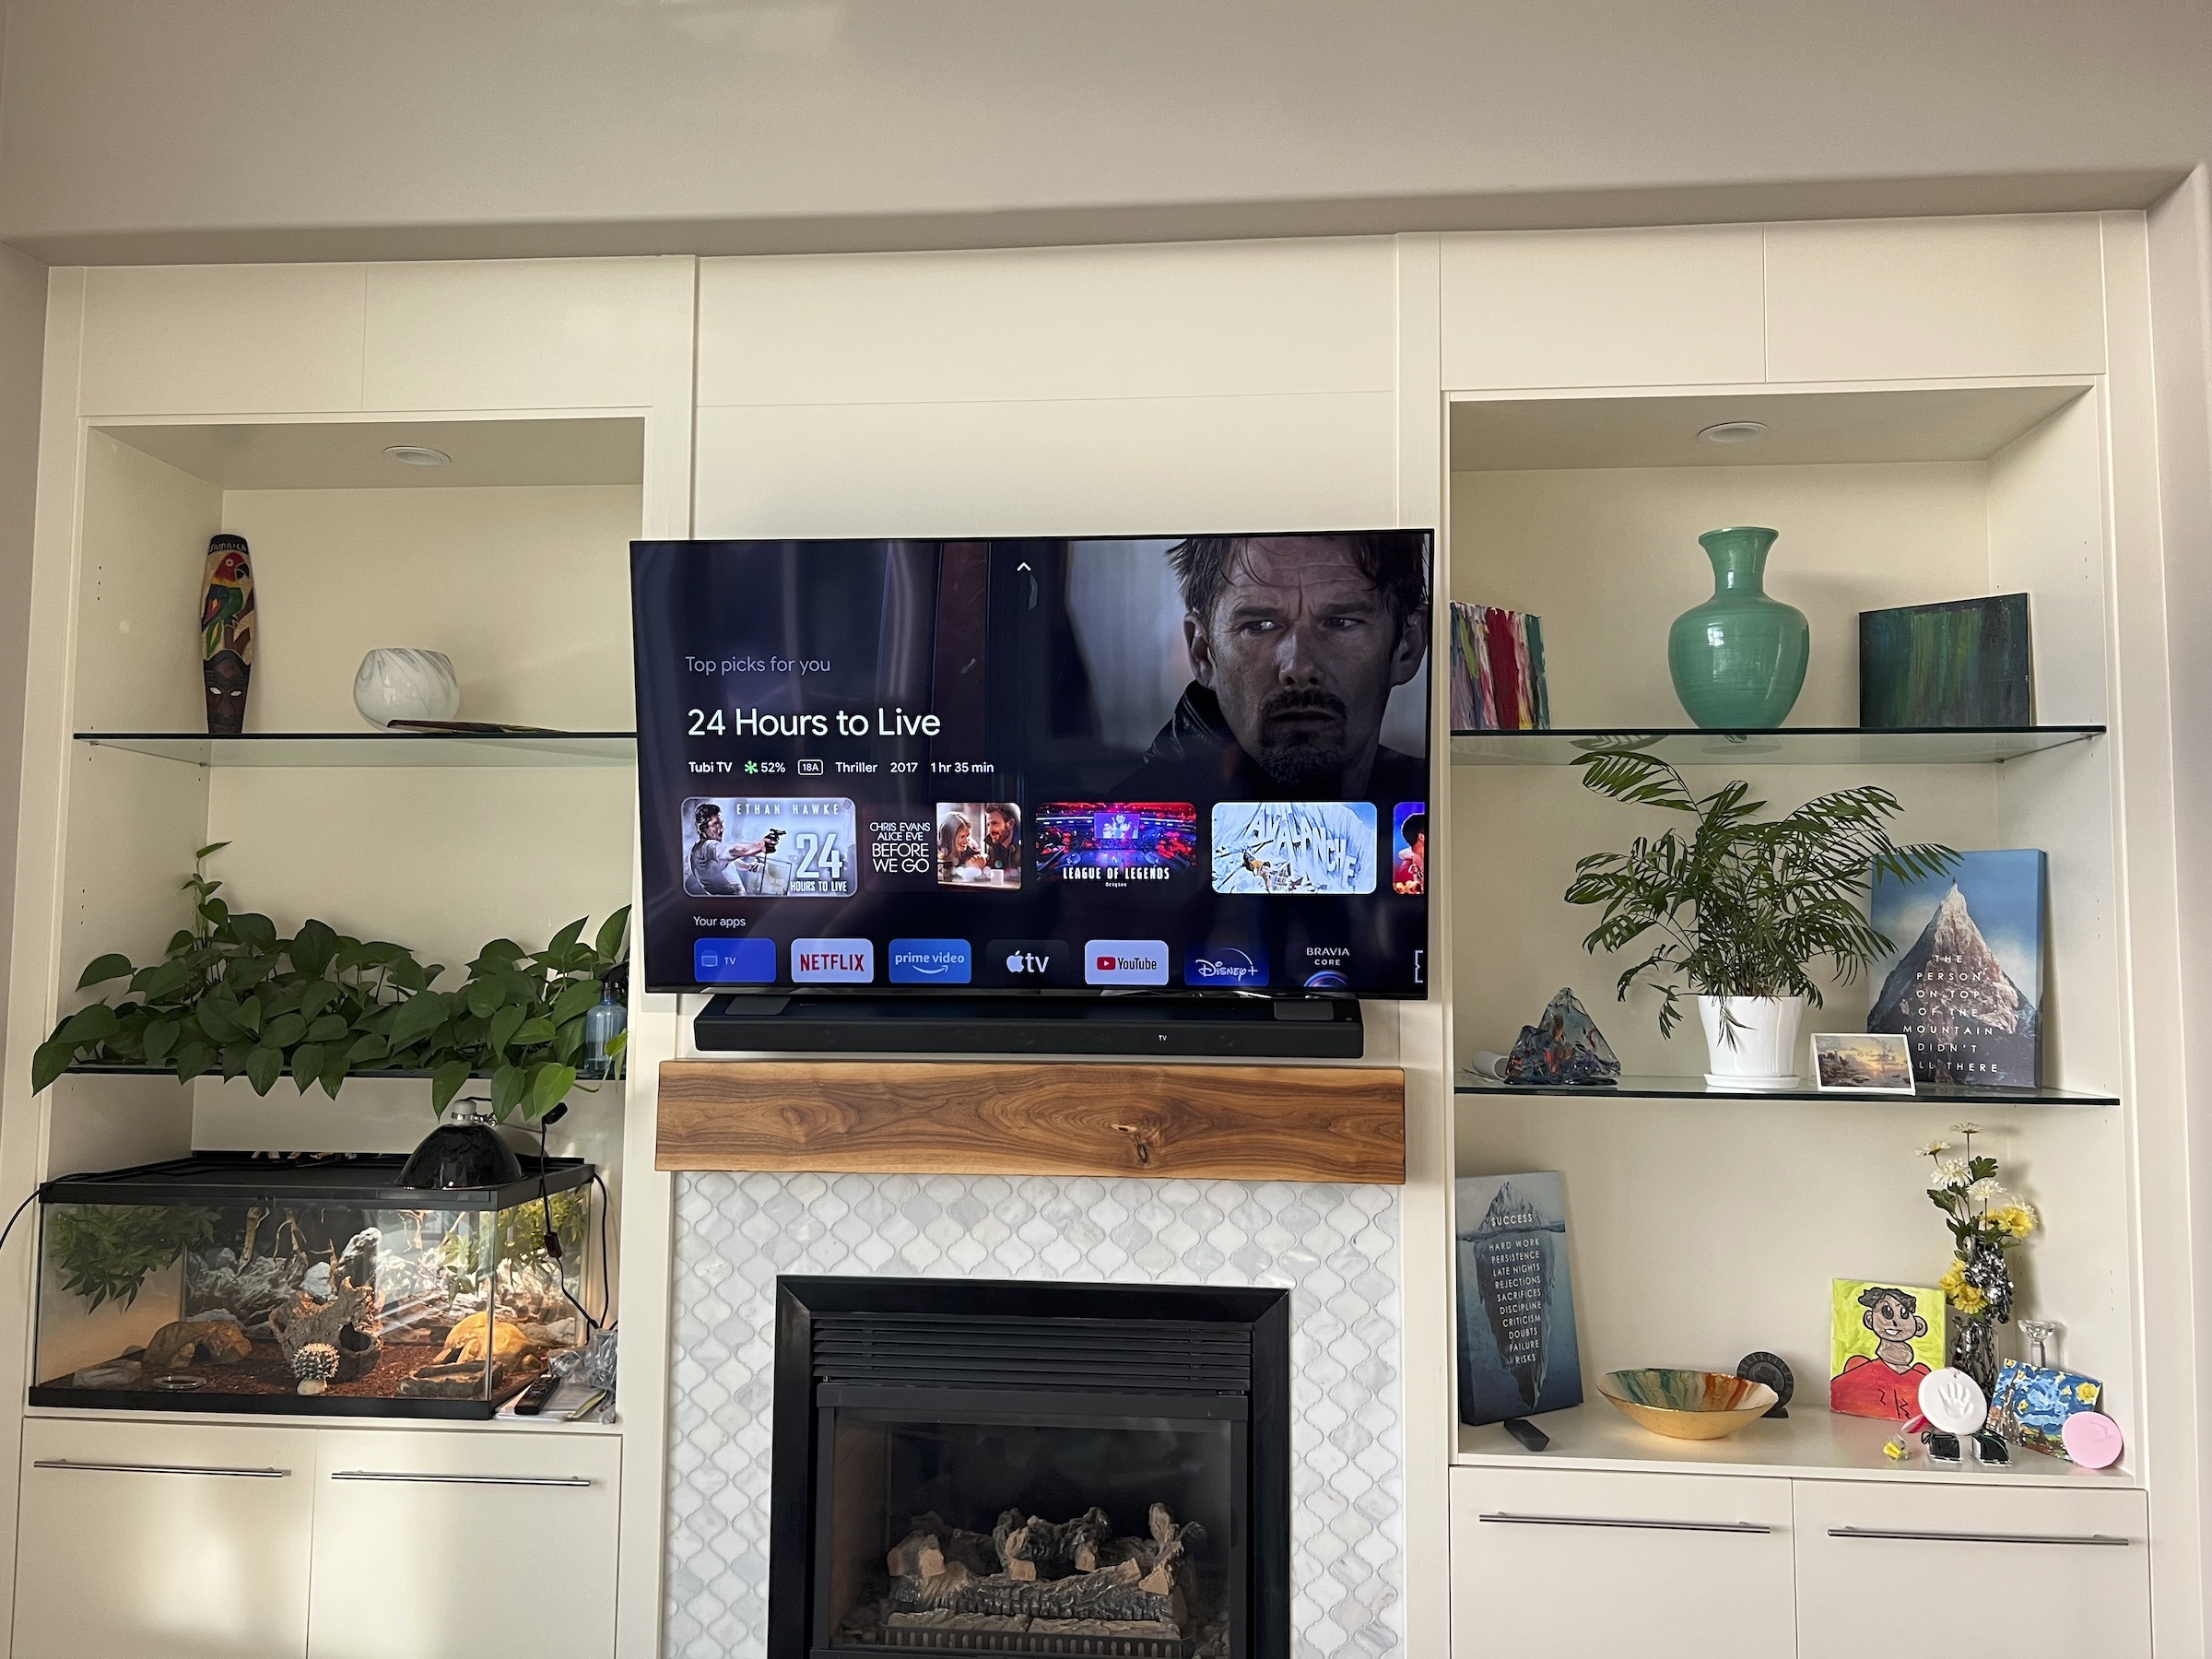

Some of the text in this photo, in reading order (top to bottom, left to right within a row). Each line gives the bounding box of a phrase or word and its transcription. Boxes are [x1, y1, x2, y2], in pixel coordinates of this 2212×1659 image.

[685, 656, 830, 676] Top picks for you
[688, 708, 941, 736] 24 Hours to Live
[688, 761, 714, 773] Tubi
[716, 762, 733, 773] TV
[760, 762, 786, 773] 52%
[802, 763, 819, 772] 18A
[835, 761, 878, 773] Thriller
[890, 762, 918, 773] 2017
[937, 761, 951, 773] hr
[954, 762, 970, 773] 35
[971, 762, 994, 773] min
[736, 804, 839, 815] ETHAN HAWKE
[869, 822, 930, 831] CHRIS EVANS
[877, 831, 924, 841] ALICE EVE
[872, 843, 929, 857] BEFORE
[1248, 809, 1357, 888] AVALANCHE
[795, 833, 842, 879] 24
[872, 858, 929, 873] WE GO
[1063, 867, 1171, 880] LEAGUE OF LEGENDS
[791, 881, 847, 892] HOURS TO LIVE
[693, 916, 746, 928] Your apps
[1306, 947, 1349, 957] BRAVIA
[724, 957, 736, 965] TV
[800, 953, 865, 972] NETFLIX
[895, 951, 965, 966] prime video
[1025, 953, 1049, 973] tv
[1118, 958, 1157, 970] YouTube
[1936, 955, 1962, 963] THE
[1916, 972, 1981, 981] PERSON
[1916, 990, 1980, 998] ON TOP
[1918, 1007, 1978, 1017] OF THE
[1902, 1025, 1993, 1036] MOUNTAIN
[1918, 1042, 1976, 1053] DIDN'T
[1947, 1063, 1998, 1073] THERE
[1491, 1214, 1533, 1227] SUCCESS
[1488, 1238, 1540, 1252] HARD WORK
[1491, 1251, 1540, 1264] PERSISTENCE
[1493, 1264, 1540, 1277] LATE NIGHTS
[1495, 1276, 1541, 1289] REJECTIONS
[1497, 1288, 1541, 1302] SACRIFICES
[1500, 1301, 1541, 1315] DISCIPLINE
[1502, 1314, 1541, 1327] CRITICISM
[1509, 1327, 1537, 1339] DOUBTS
[1509, 1340, 1539, 1352] FAILURE
[1515, 1354, 1536, 1364] RISKS
